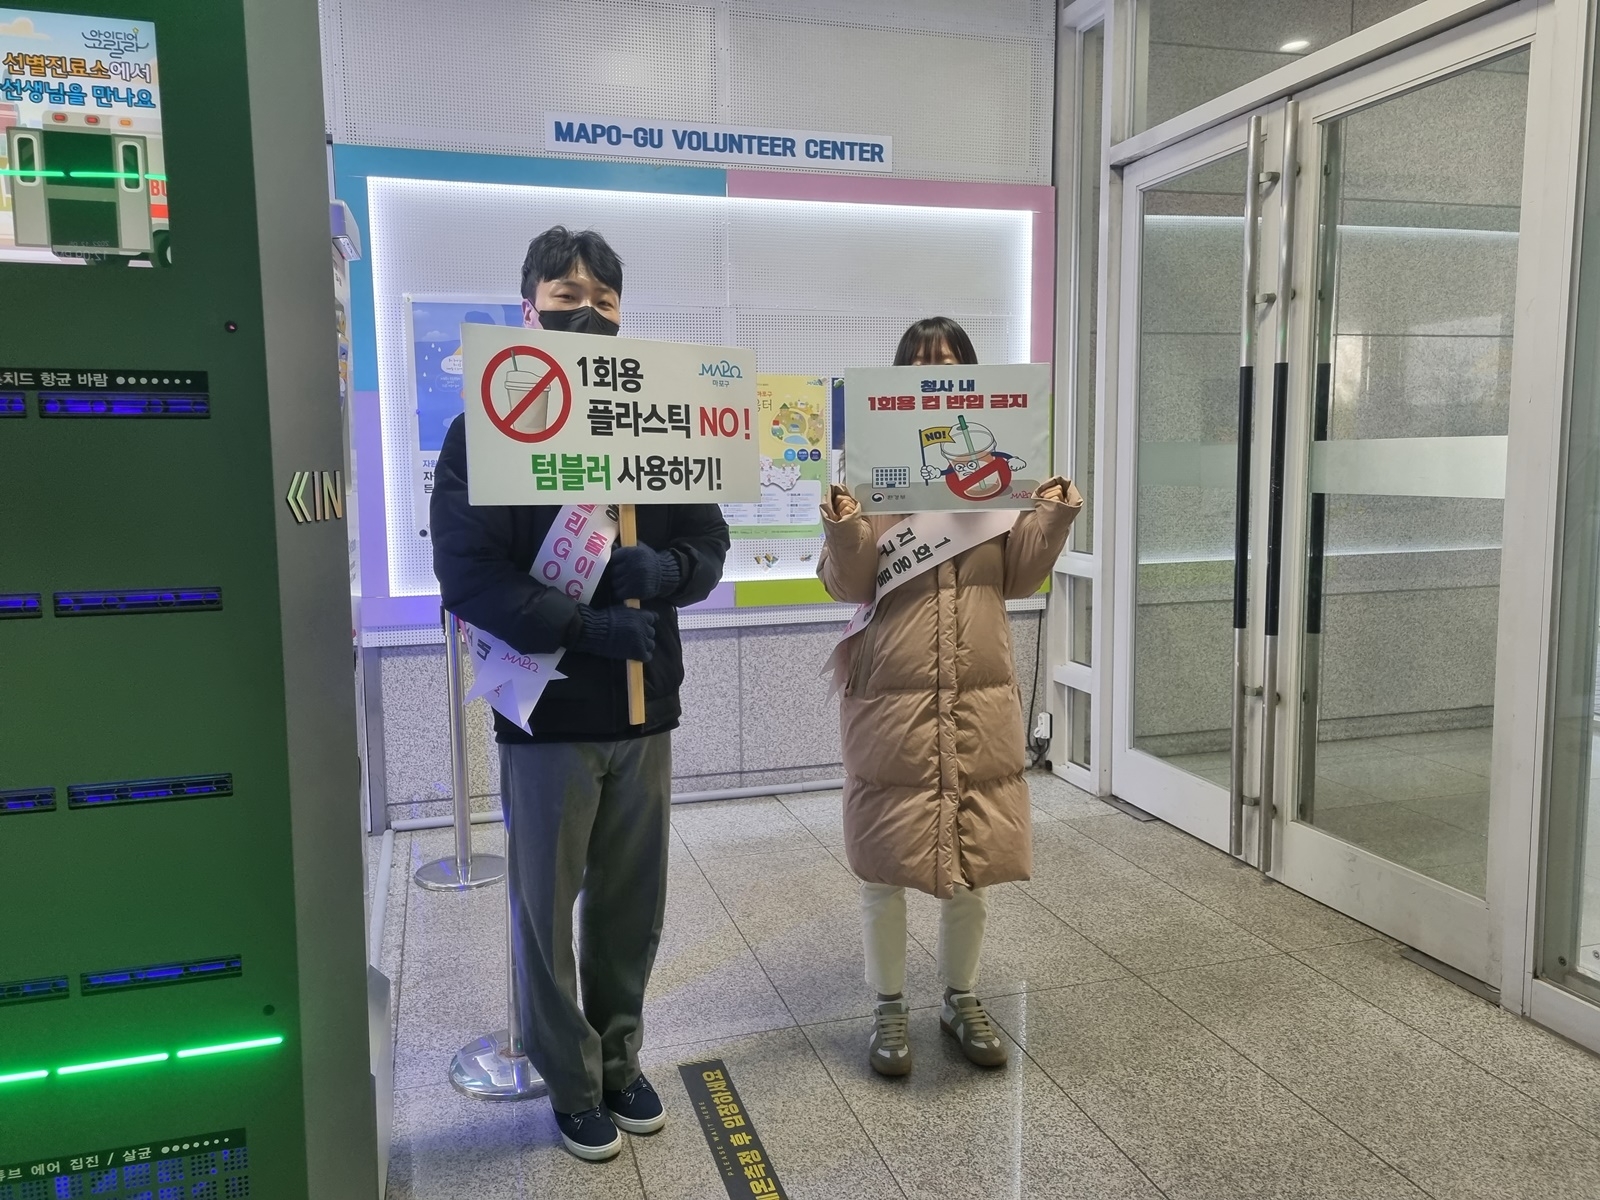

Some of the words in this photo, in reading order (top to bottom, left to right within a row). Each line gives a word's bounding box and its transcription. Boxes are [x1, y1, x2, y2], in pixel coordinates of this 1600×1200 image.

[90, 29, 138, 41] 아이디어
[2, 52, 151, 83] 선별진료소에서
[0, 78, 87, 106] 선생님을
[92, 85, 156, 108] 만나요
[554, 120, 663, 149] MAPO-GU
[672, 129, 796, 157] VOLUNTEER
[805, 139, 885, 163] CENTER
[577, 355, 644, 393] 1회용
[699, 360, 743, 379] MAPO
[41, 372, 72, 387] 항균
[77, 373, 108, 388] 바람
[712, 379, 730, 388] 마포구
[920, 379, 954, 392] 청사
[958, 379, 975, 392] 내
[757, 399, 773, 412] 터
[868, 395, 915, 411] 1회용
[921, 395, 940, 411] 컵
[946, 394, 984, 410] 반입
[990, 393, 1028, 409] 금지
[586, 398, 691, 439] 플라스틱
[699, 406, 751, 440] NO!
[925, 430, 946, 442] NO!
[531, 453, 611, 491] 텀블러
[617, 455, 722, 491] 사용하기!
[313, 470, 342, 521] IN
[880, 527, 917, 558] 지구
[698, 1101, 709, 1120] HERE
[707, 1123, 719, 1142] WAIT
[729, 1131, 754, 1147] 후
[31, 1161, 61, 1176] 에어
[70, 1154, 99, 1171] 집진
[122, 1147, 152, 1162] 살균
[717, 1145, 735, 1177] PLEASE
